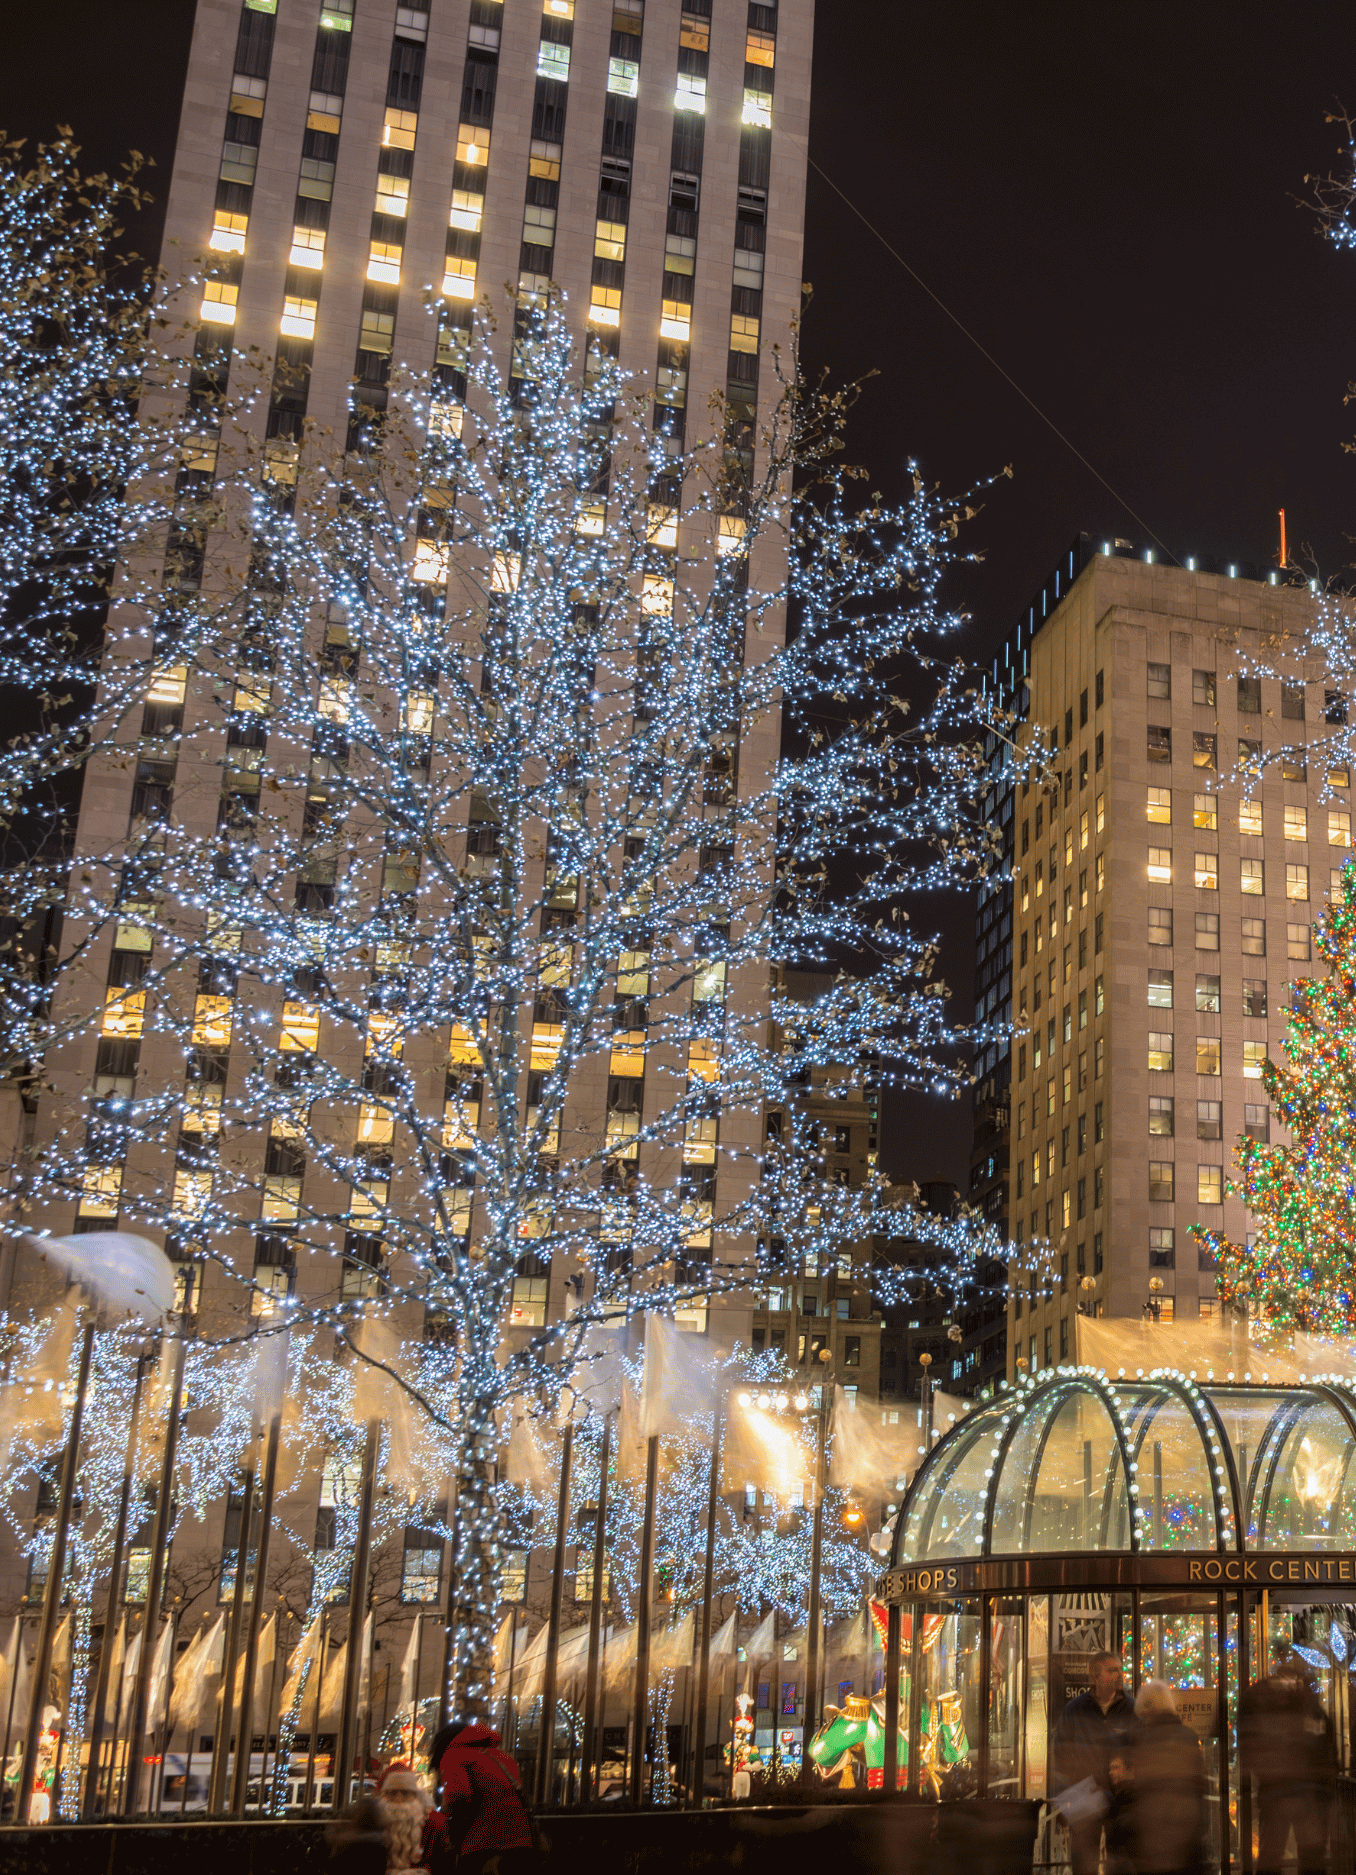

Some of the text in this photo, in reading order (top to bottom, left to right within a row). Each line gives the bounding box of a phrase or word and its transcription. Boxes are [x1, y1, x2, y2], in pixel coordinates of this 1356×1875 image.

[1189, 1560, 1258, 1580] ROCK
[898, 1568, 958, 1593] SHOPS
[1175, 1703, 1213, 1713] CENTER
